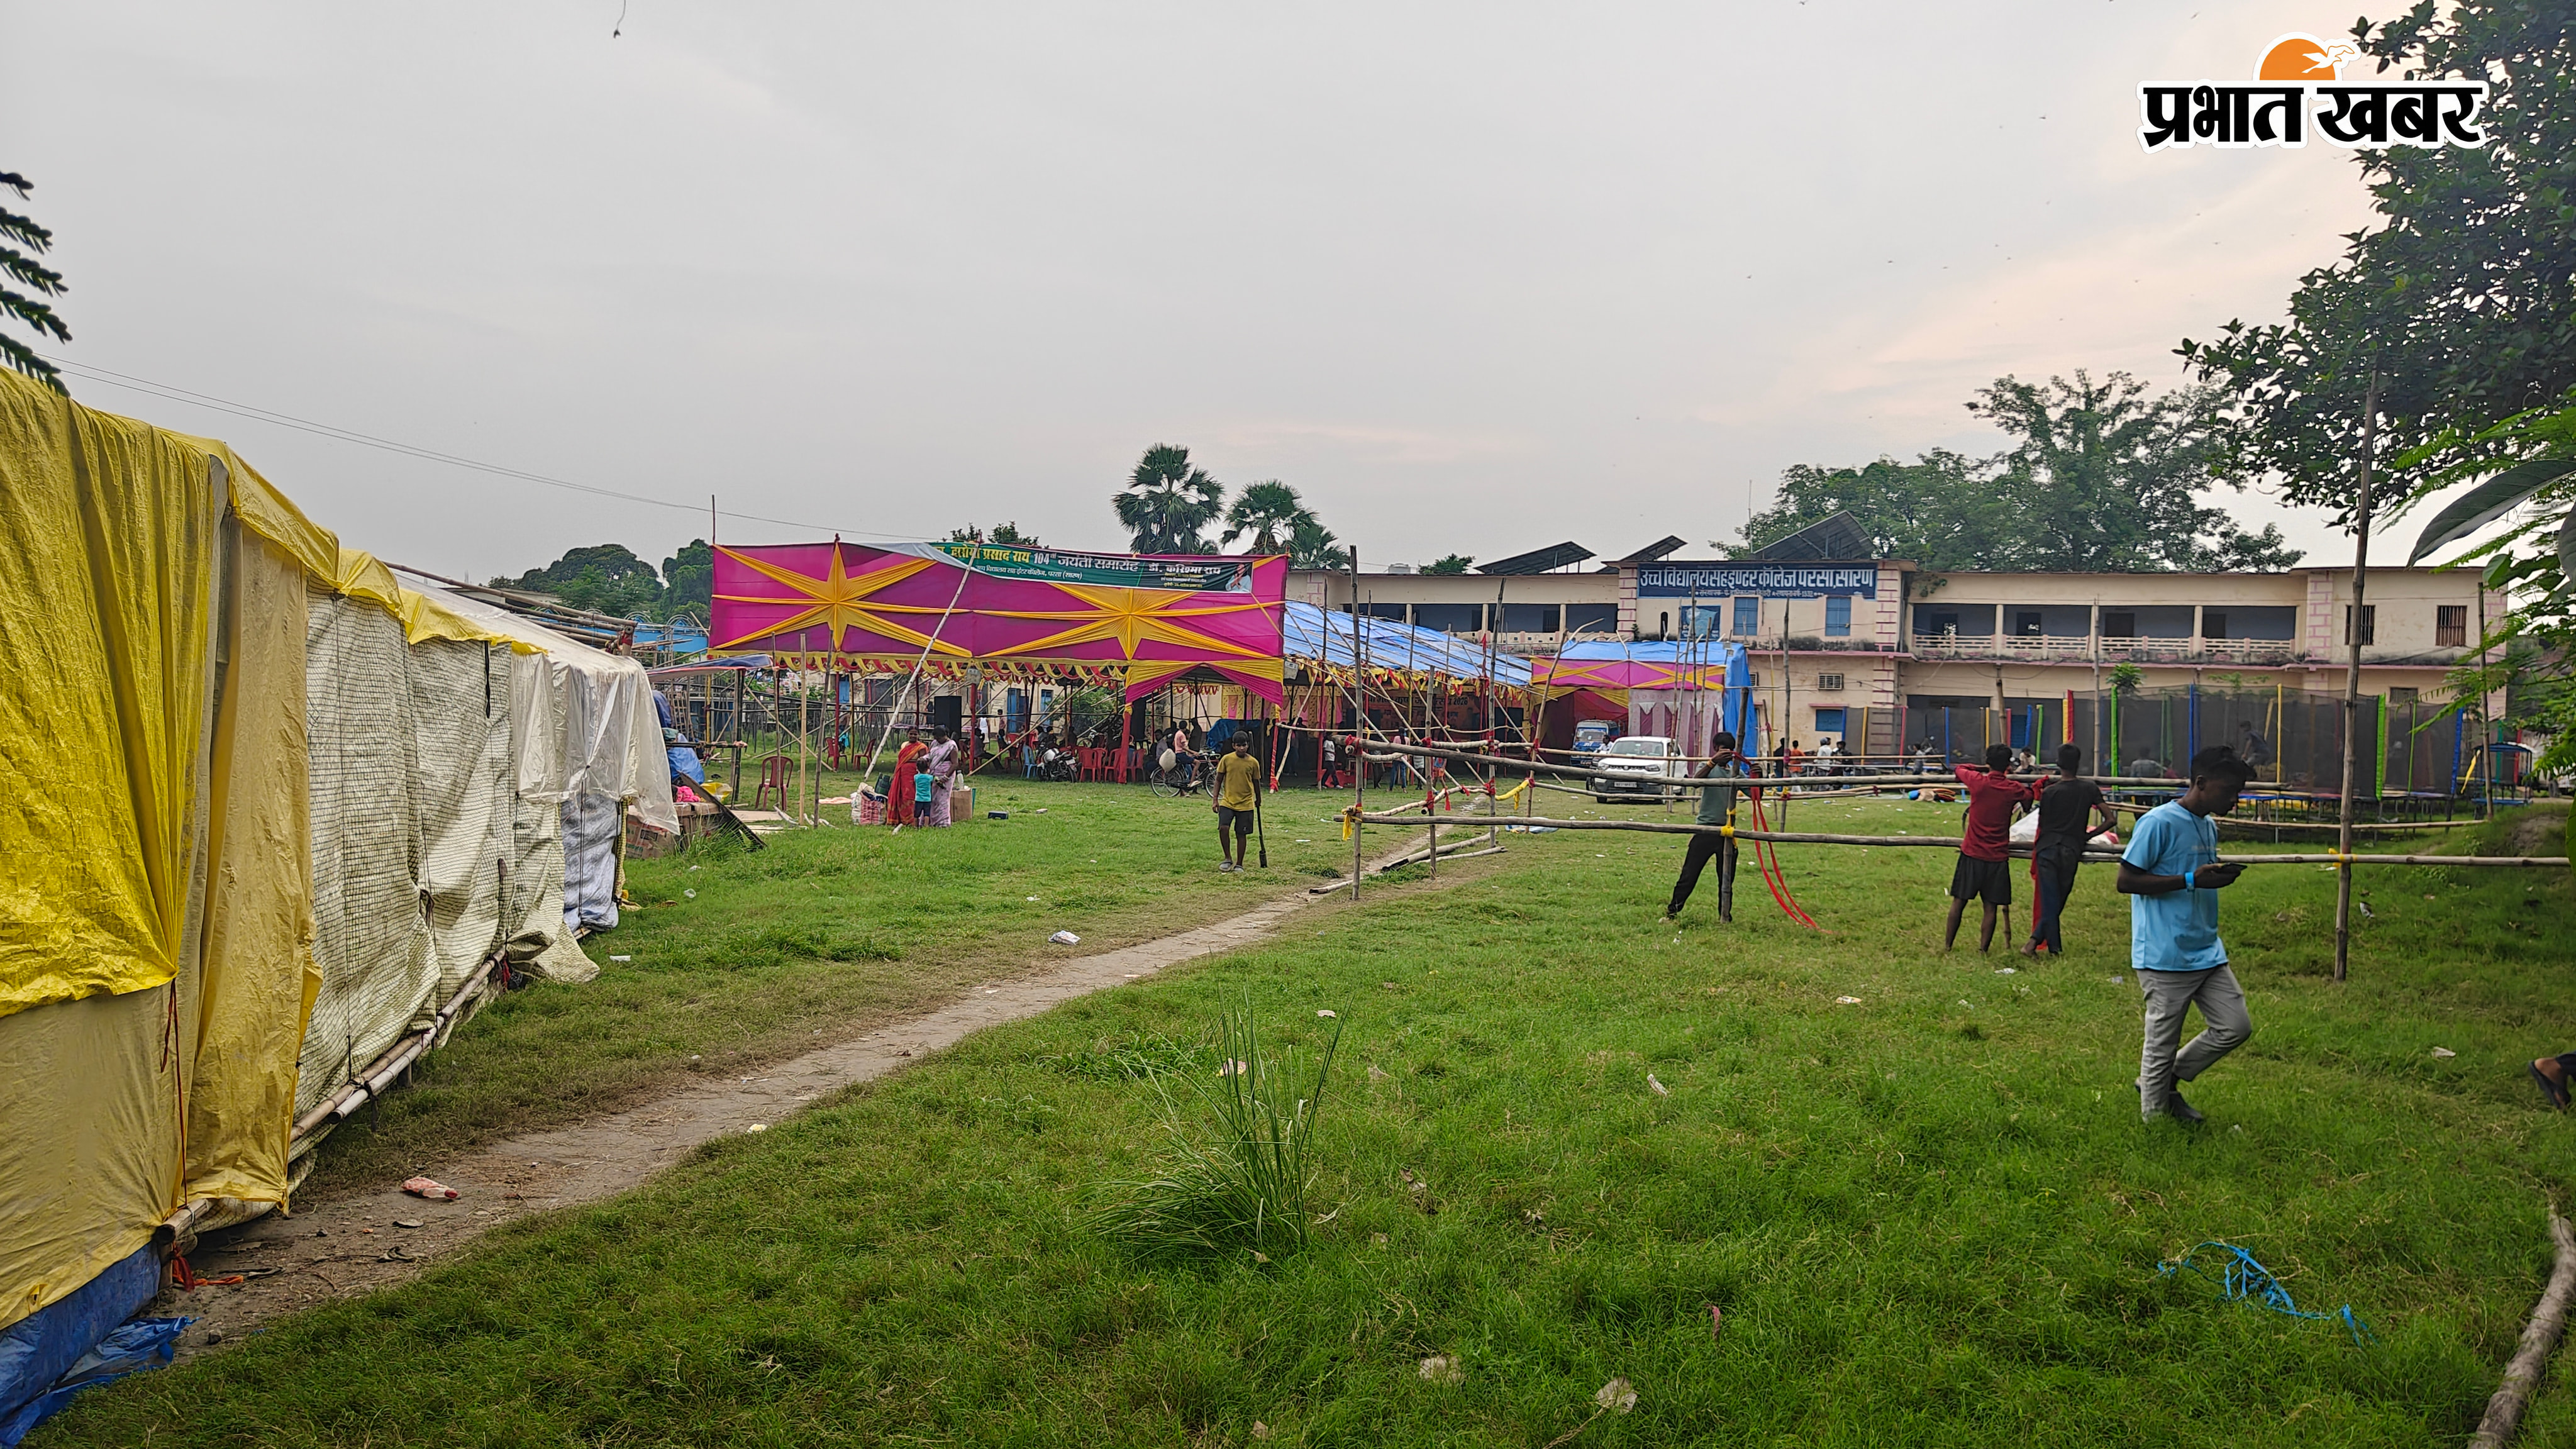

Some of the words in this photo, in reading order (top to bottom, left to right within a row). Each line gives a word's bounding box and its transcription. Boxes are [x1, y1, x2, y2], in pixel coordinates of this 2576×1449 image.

[983, 548, 1011, 561] प्रसाद
[1012, 551, 1031, 564] राय
[1058, 554, 1093, 569] जयंती
[1094, 557, 1140, 572] समारोह
[1148, 562, 1163, 572] डॉ.
[1165, 564, 1202, 574] करिश्मा
[1204, 566, 1222, 575] राय
[1640, 569, 1662, 587] उच्च
[1758, 566, 1797, 587] कॉलेज
[1836, 569, 1874, 587] सारण
